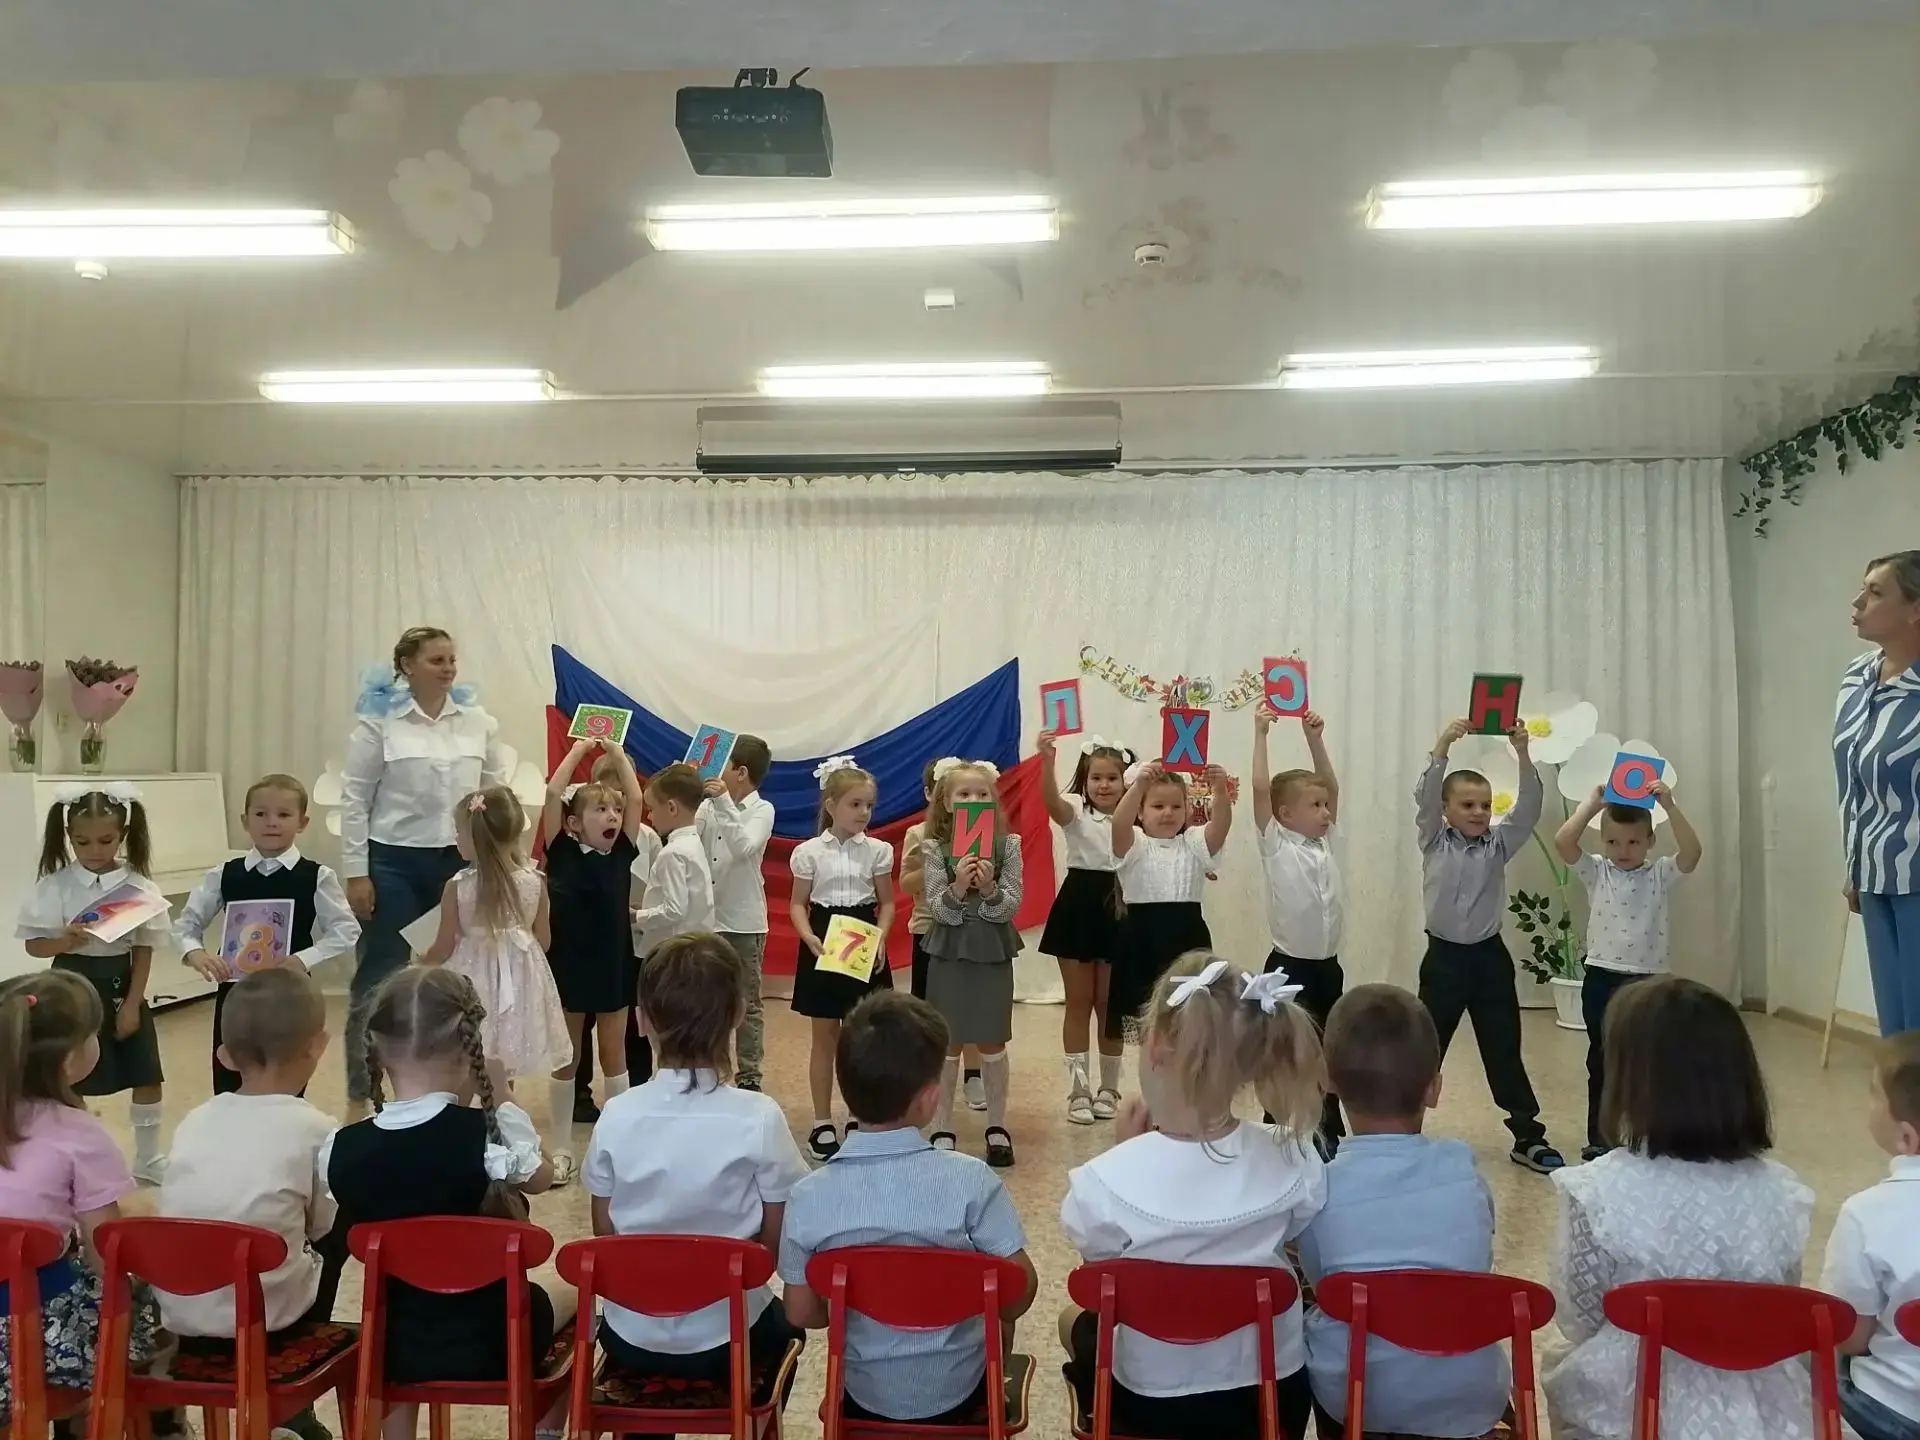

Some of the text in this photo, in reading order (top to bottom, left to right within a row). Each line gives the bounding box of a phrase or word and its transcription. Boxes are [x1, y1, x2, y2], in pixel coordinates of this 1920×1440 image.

[585, 714, 615, 738] 9
[1165, 713, 1208, 766] Х
[700, 732, 721, 768] 1
[952, 808, 996, 858] И
[235, 924, 276, 975] 8
[839, 928, 867, 962] 7
